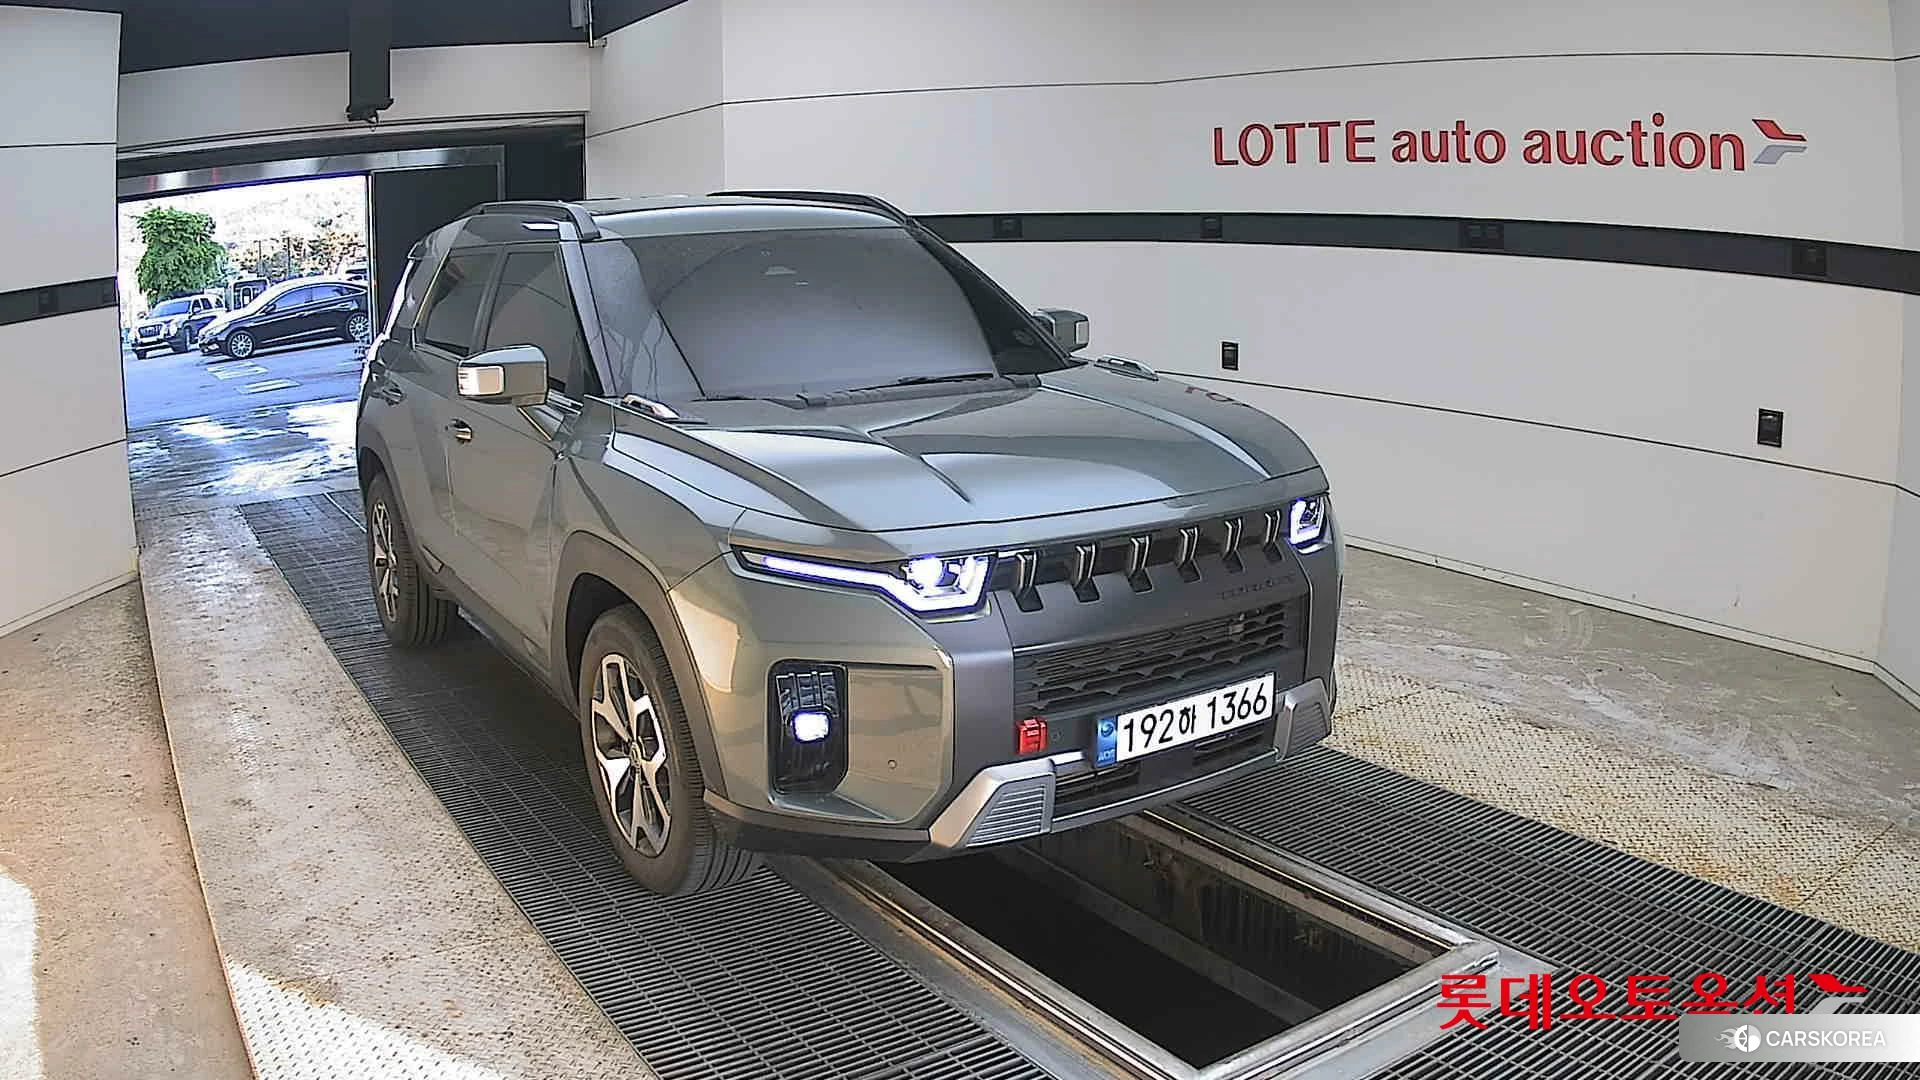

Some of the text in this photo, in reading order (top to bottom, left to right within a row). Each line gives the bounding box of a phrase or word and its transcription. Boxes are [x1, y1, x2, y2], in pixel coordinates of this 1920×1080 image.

[1213, 112, 1745, 171] LOTTE auto auction
[1122, 682, 1268, 753] 192하 1366
